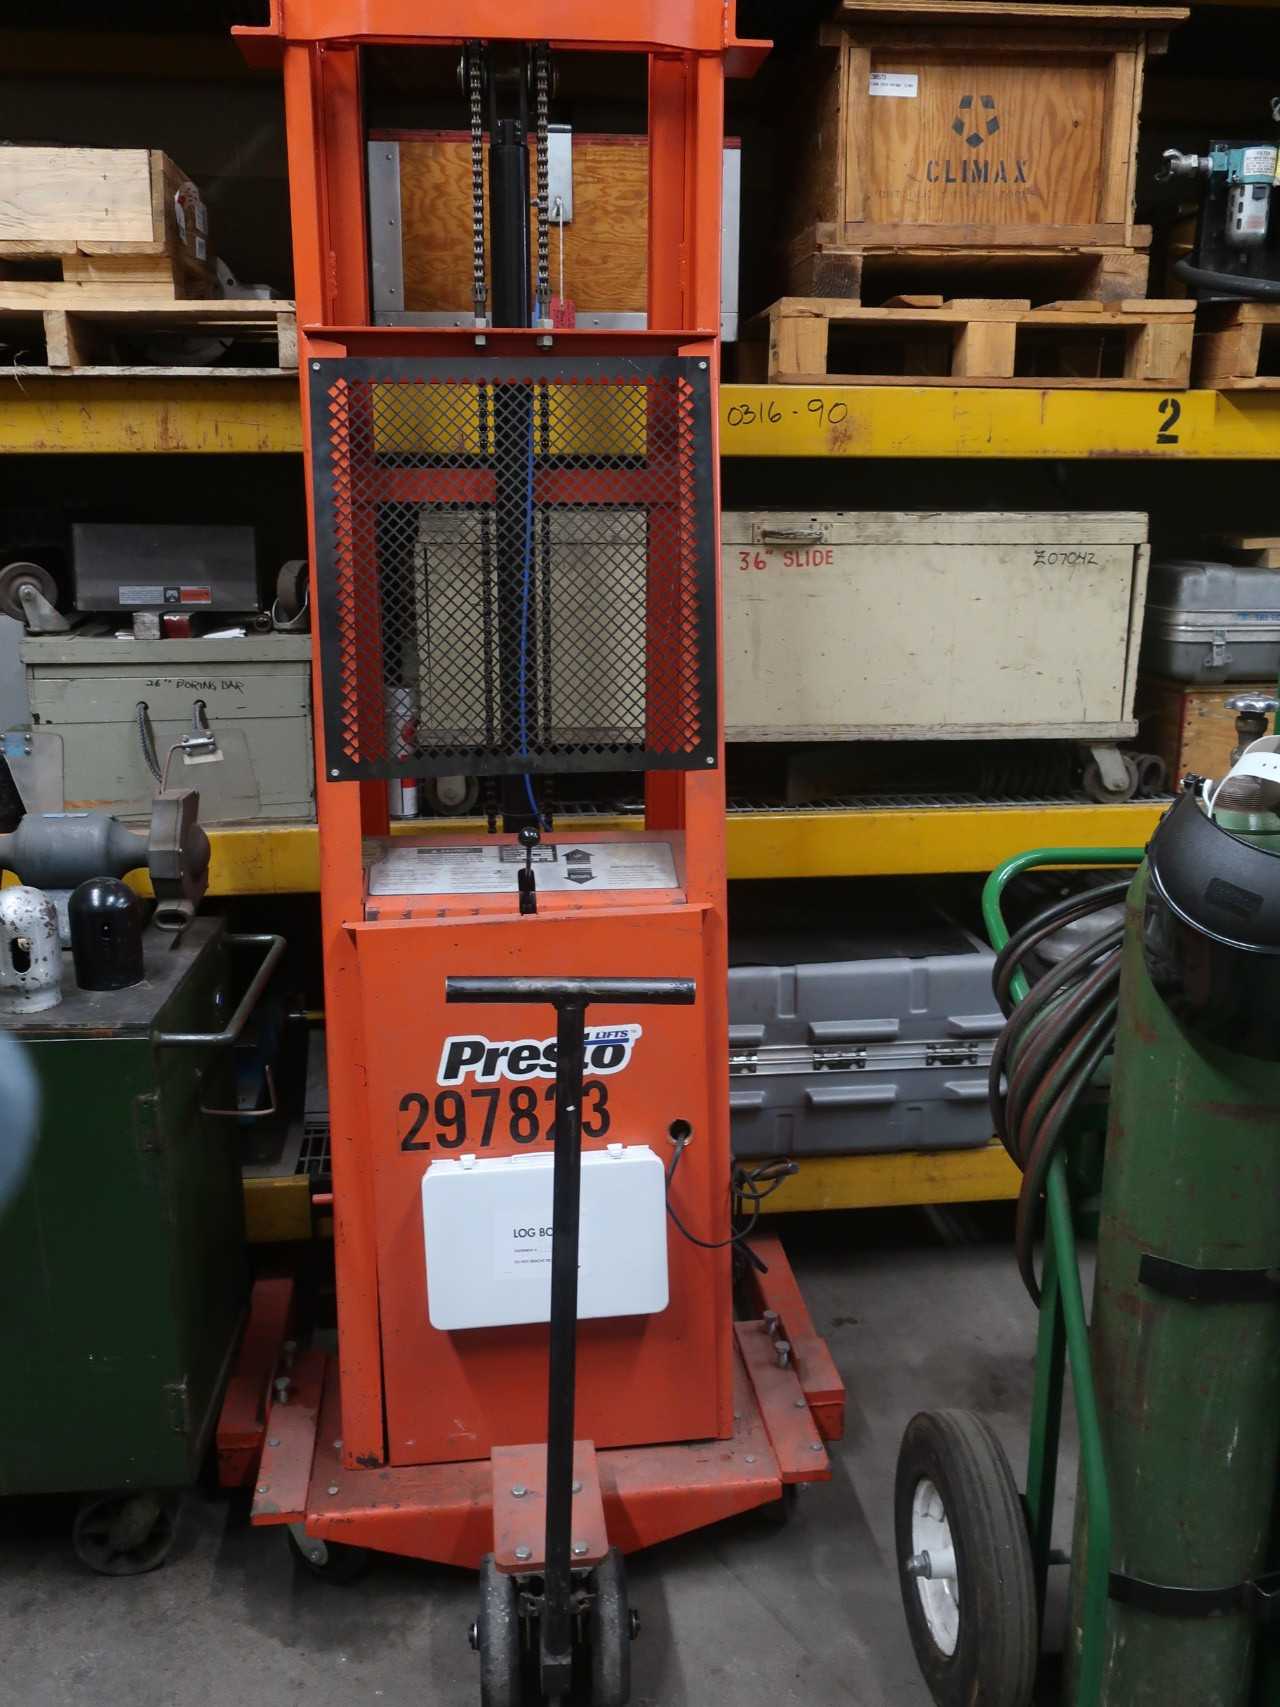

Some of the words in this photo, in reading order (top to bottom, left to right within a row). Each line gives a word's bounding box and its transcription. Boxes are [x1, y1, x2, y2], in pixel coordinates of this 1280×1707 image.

[927, 159, 1027, 183] CLIMAX
[1156, 398, 1181, 445] 2
[783, 549, 834, 568] SLIDE
[594, 1029, 630, 1040] LIFTS
[512, 1227, 536, 1239] LOG
